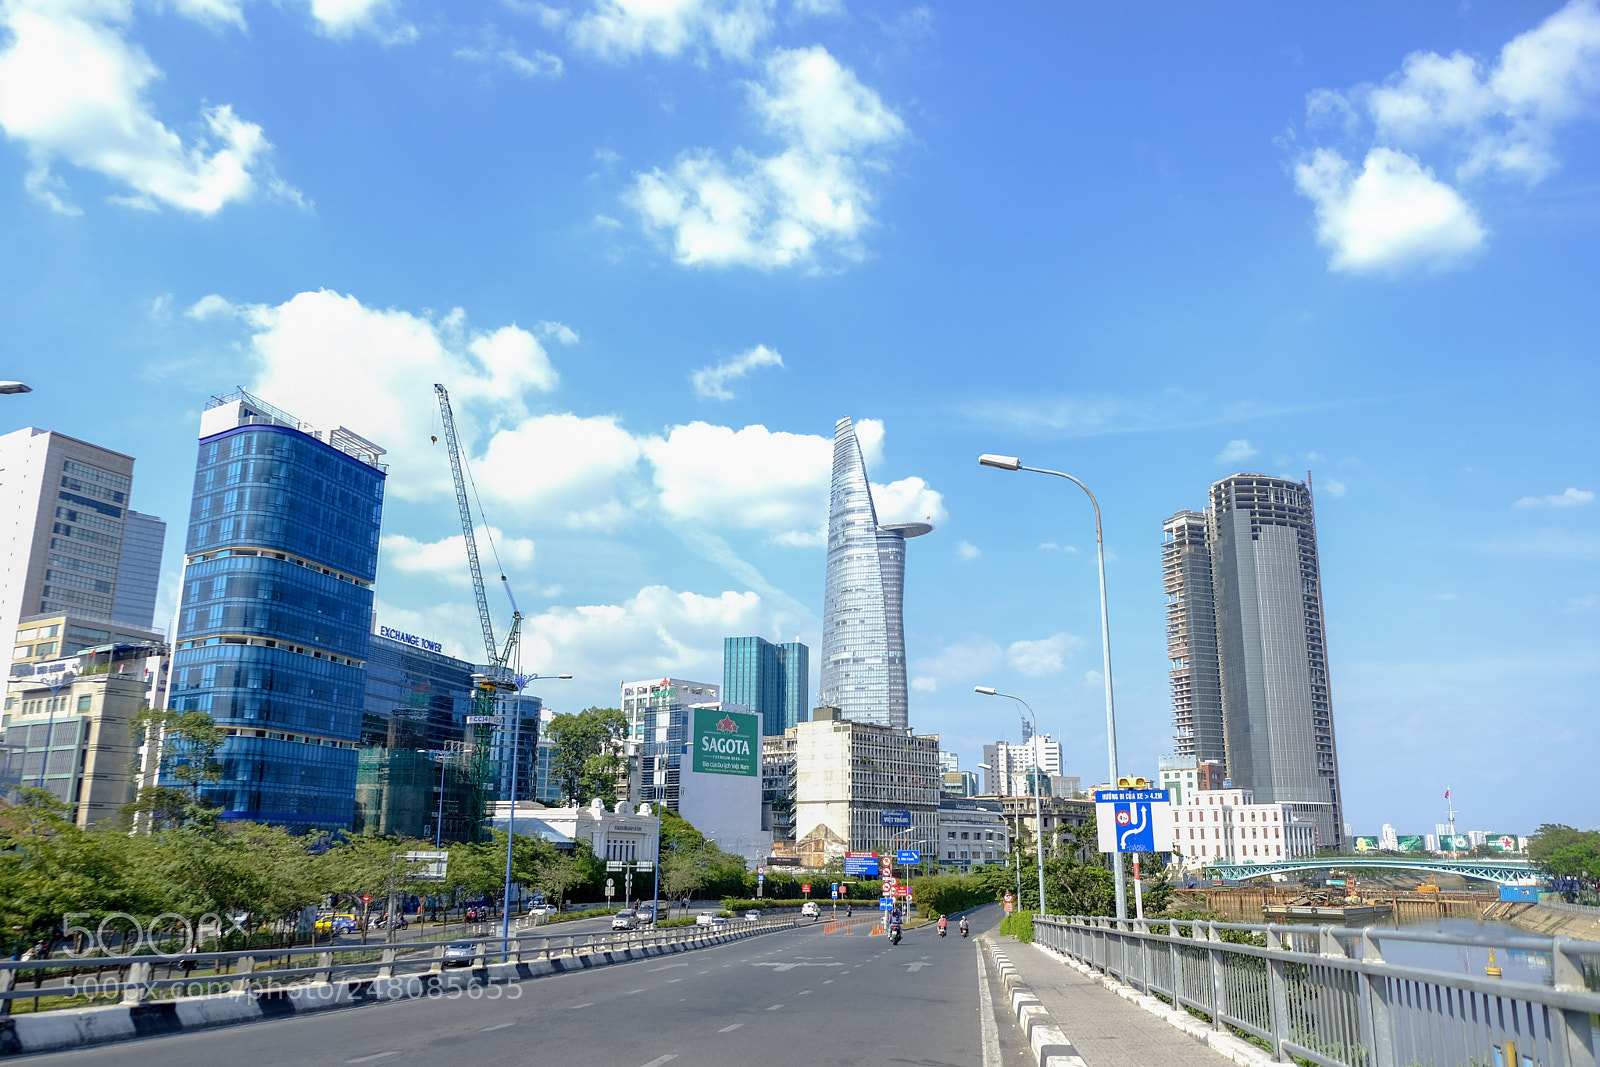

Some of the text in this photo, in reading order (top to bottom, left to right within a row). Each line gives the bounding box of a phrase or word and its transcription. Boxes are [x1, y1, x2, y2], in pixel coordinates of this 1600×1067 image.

[380, 625, 442, 653] EXCHANGE TOWER
[702, 736, 750, 755] SAGOTA
